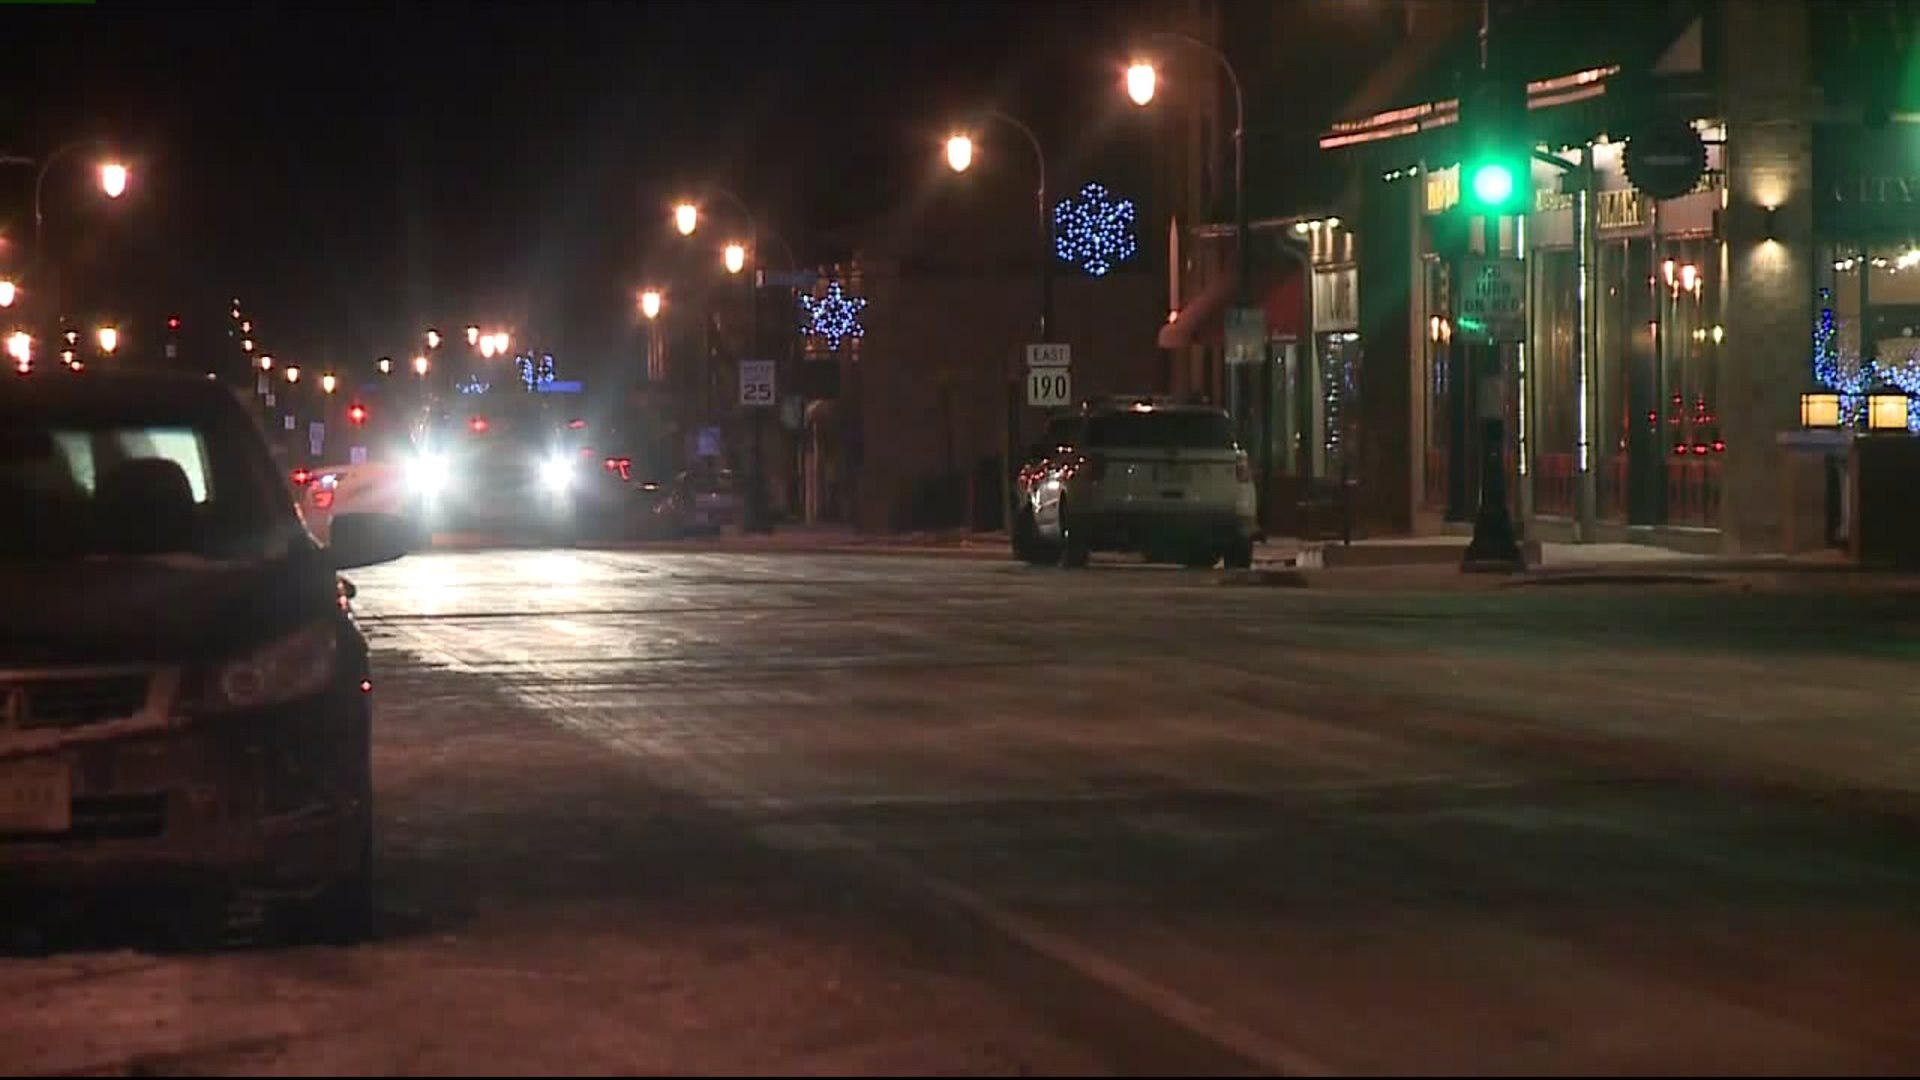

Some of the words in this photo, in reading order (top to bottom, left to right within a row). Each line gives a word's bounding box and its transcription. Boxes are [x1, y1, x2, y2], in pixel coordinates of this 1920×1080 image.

[1032, 347, 1065, 361] EAST
[743, 383, 771, 401] 25
[1033, 375, 1066, 399] 190
